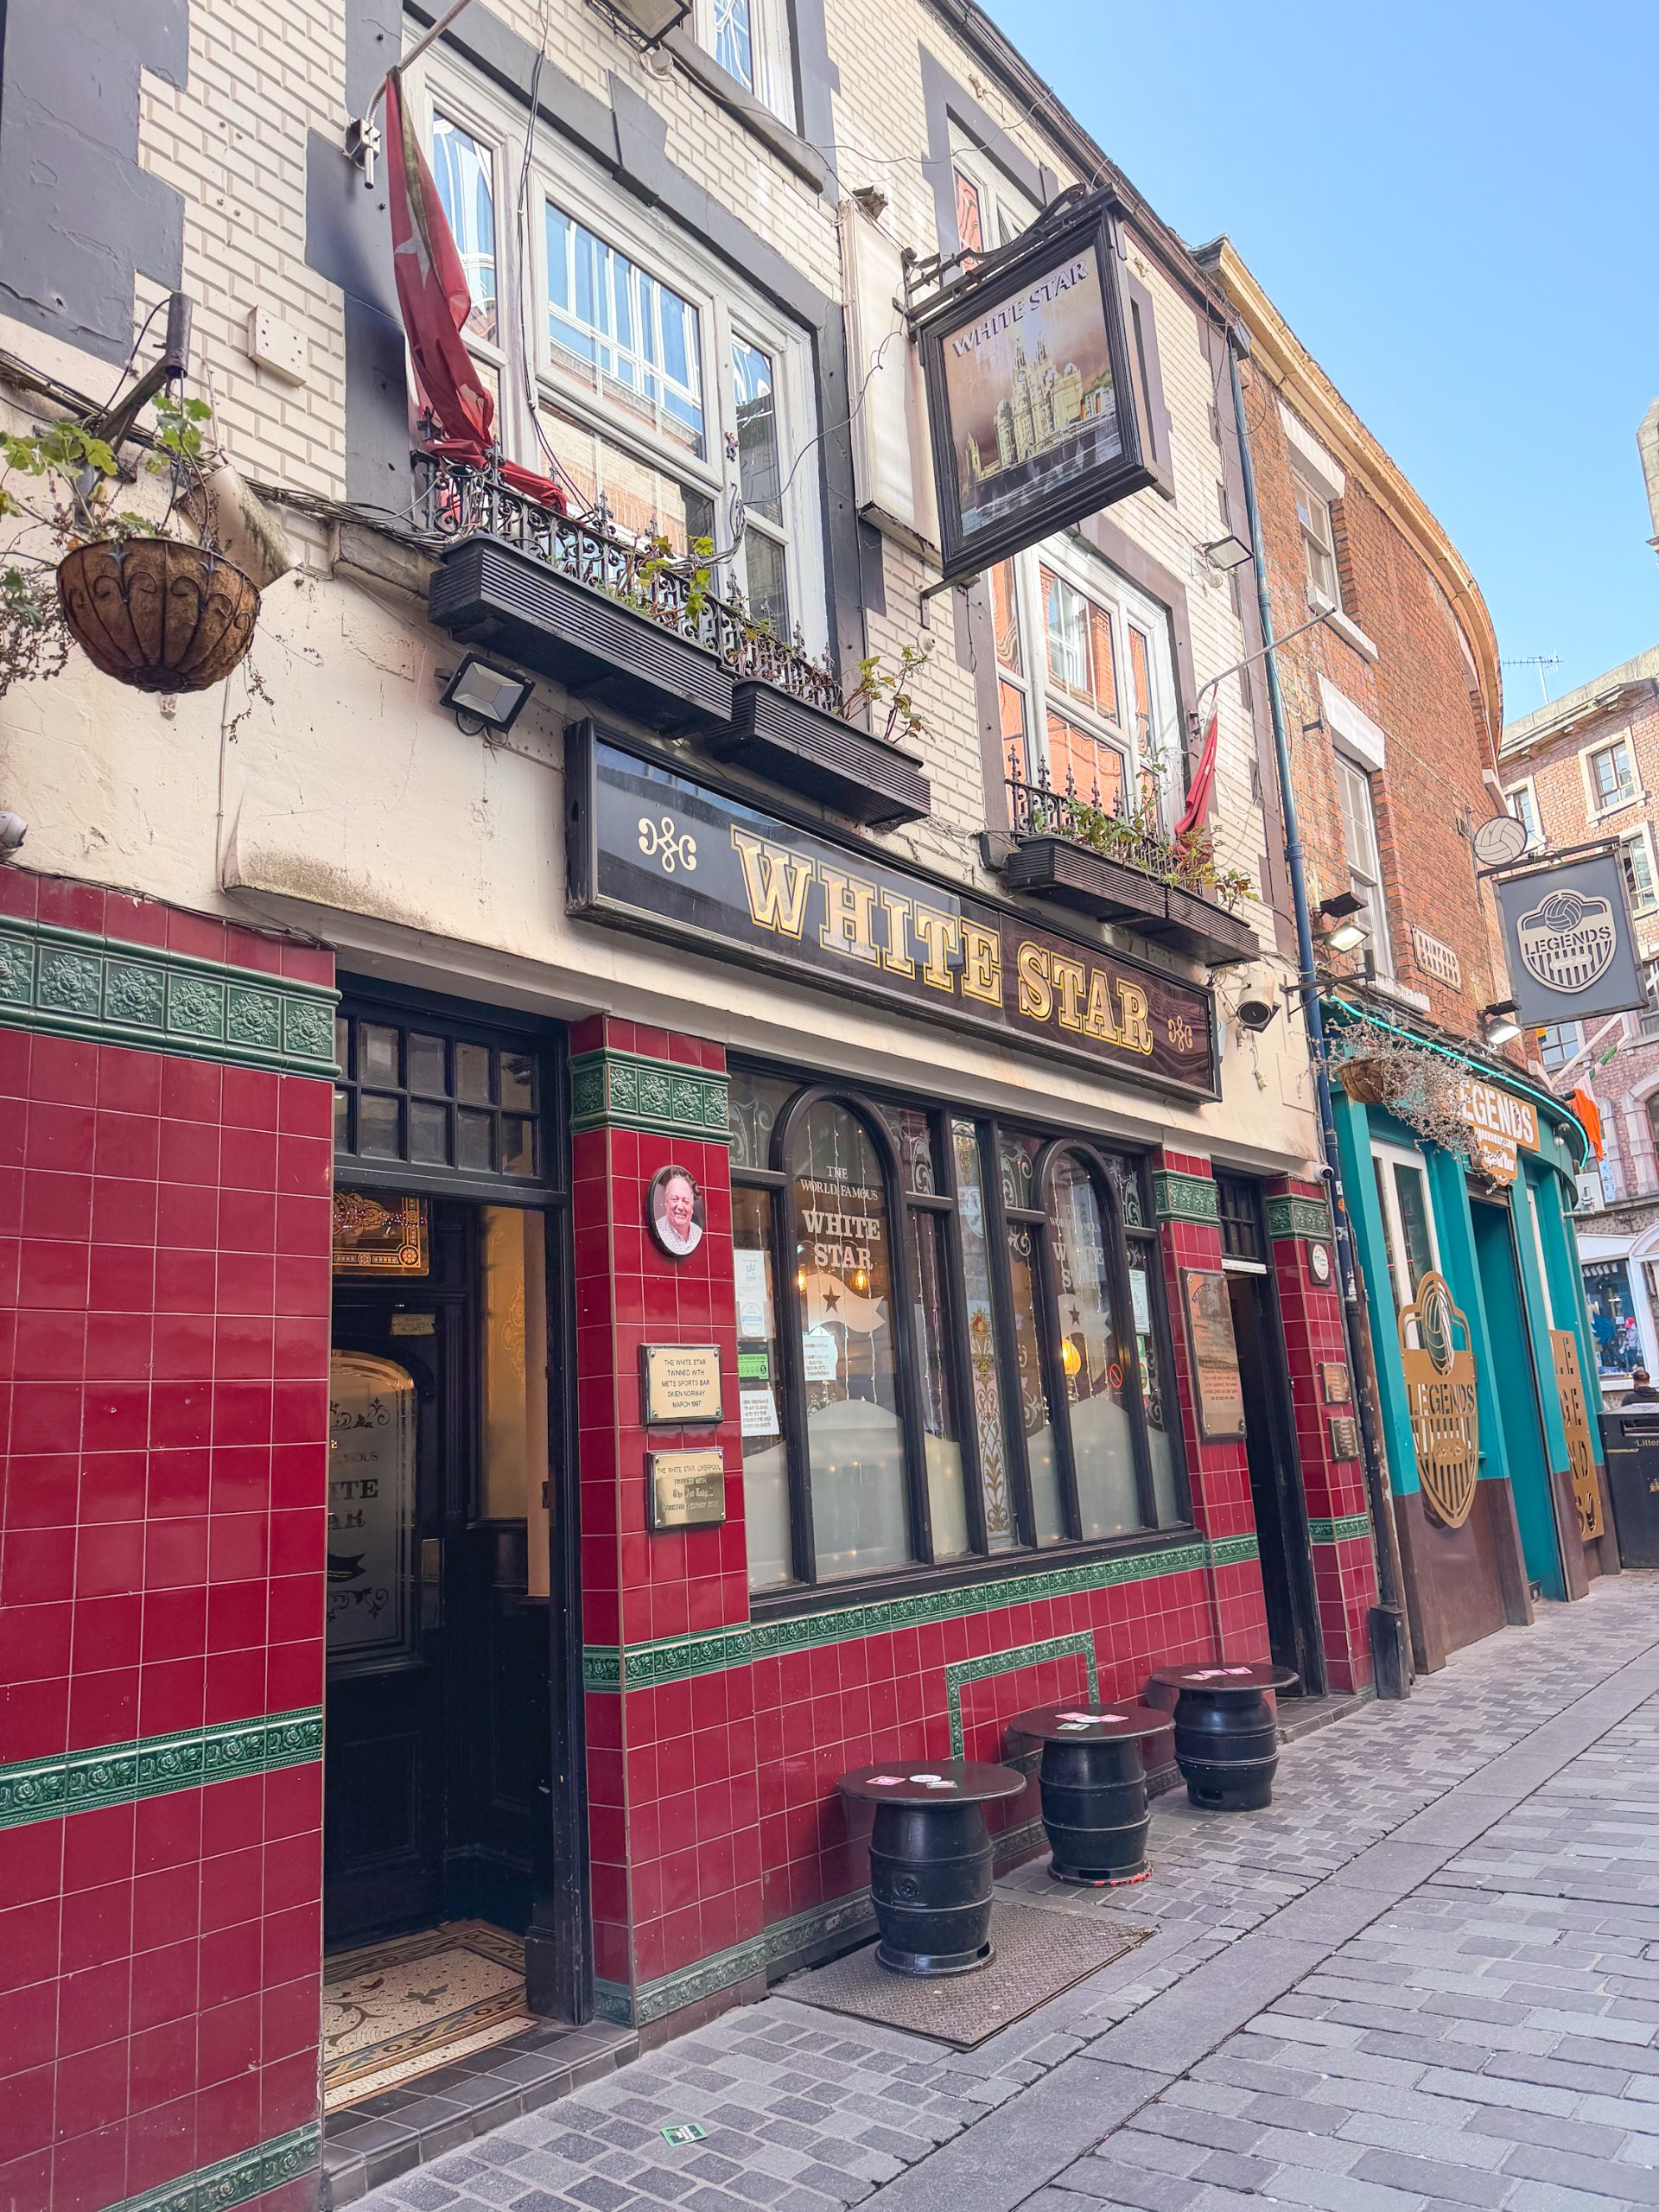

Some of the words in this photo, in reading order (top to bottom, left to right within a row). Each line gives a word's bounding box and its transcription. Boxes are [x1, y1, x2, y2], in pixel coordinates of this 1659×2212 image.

[952, 297, 1027, 357] WHITE
[1030, 259, 1090, 311] STAR
[730, 824, 1002, 1007] WHITE
[1017, 940, 1154, 1056] STAR
[1418, 934, 1456, 967] RAINFORD
[1524, 926, 1611, 956] LEGENDS
[1421, 951, 1458, 982] GARDENS
[1459, 1084, 1534, 1144] EGENDS
[827, 1166, 849, 1179] THE
[800, 1179, 837, 1195] WORLD
[841, 1185, 879, 1201] FAMOUS
[802, 1210, 880, 1240] WHITE
[814, 1243, 873, 1270] STAR
[1408, 1383, 1475, 1416] LEGENDS
[329, 1478, 378, 1501] ITE
[328, 1508, 365, 1530] AR
